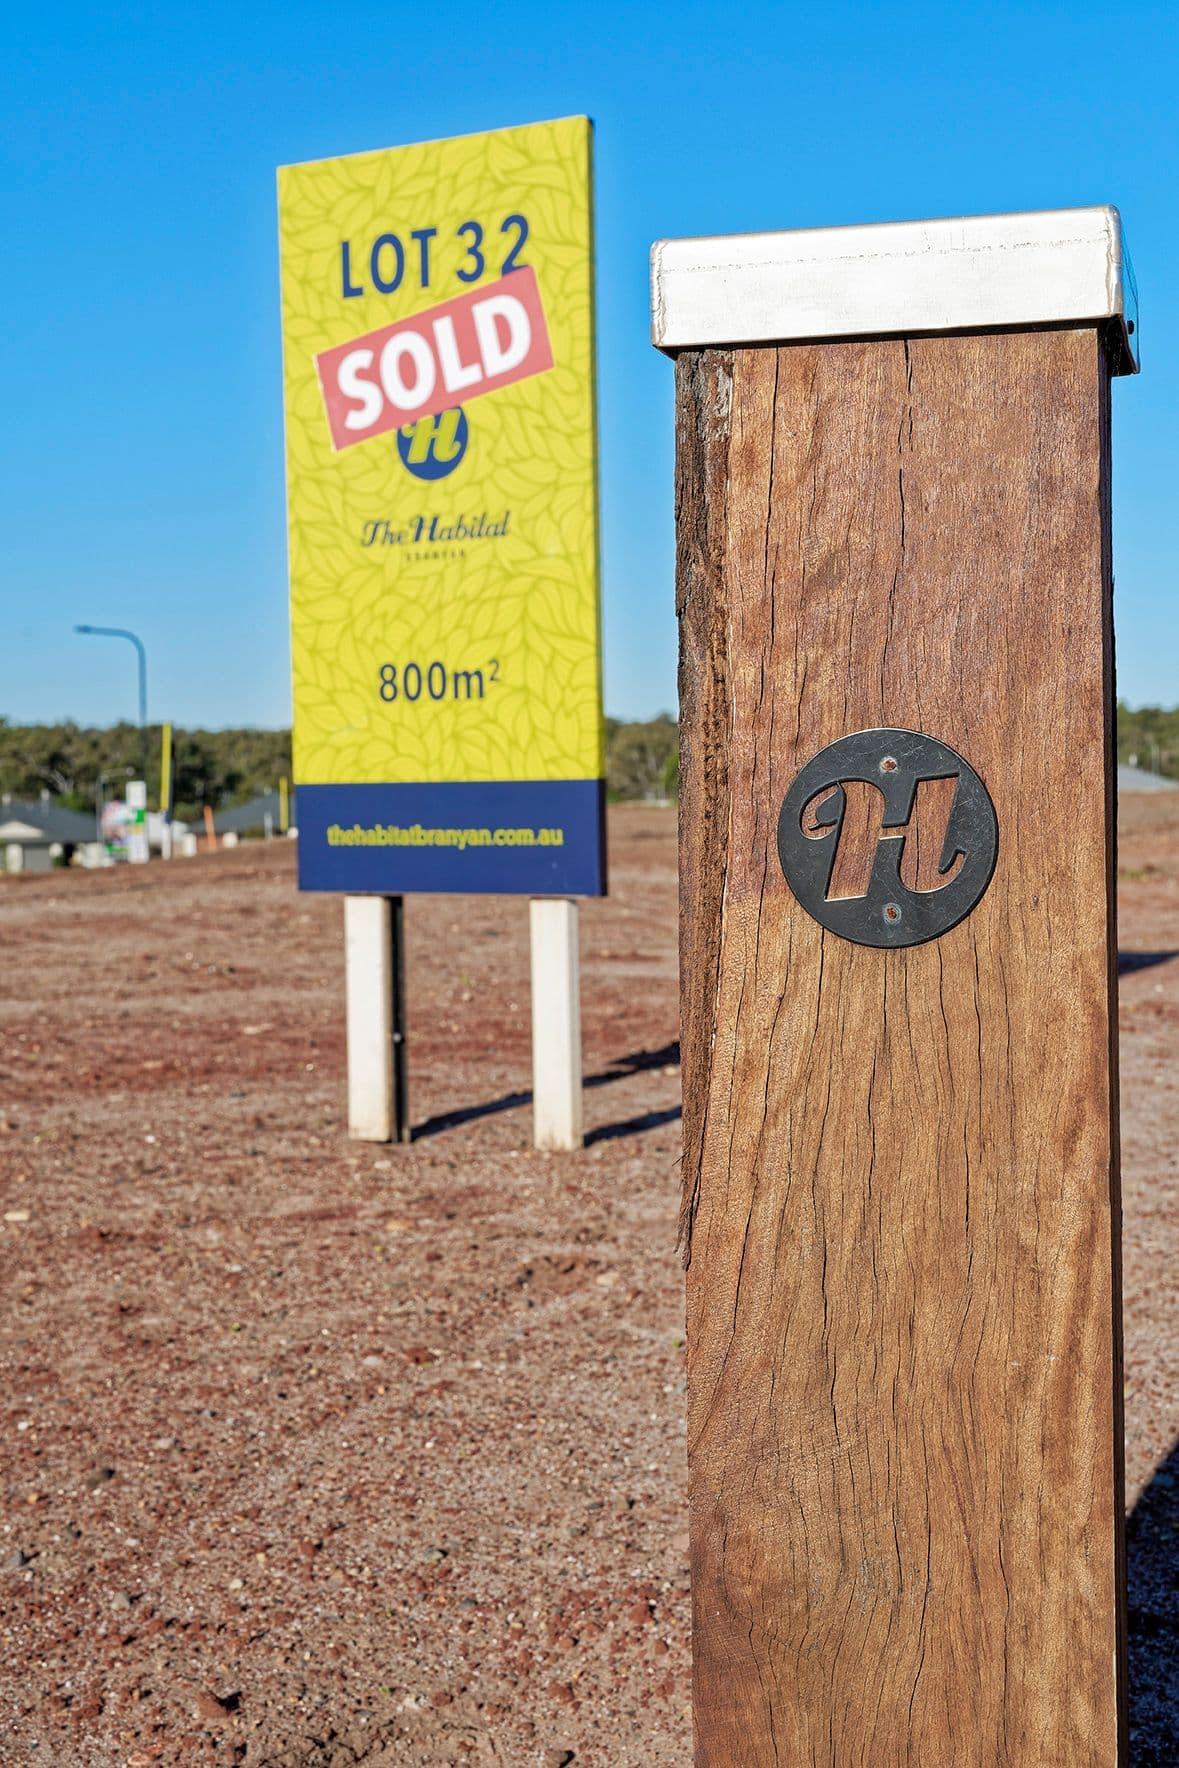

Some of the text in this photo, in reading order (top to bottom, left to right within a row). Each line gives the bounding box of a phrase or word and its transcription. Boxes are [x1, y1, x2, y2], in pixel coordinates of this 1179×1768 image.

[340, 214, 530, 298] LOT 32
[337, 294, 532, 430] SOLD
[401, 409, 462, 464] H
[361, 519, 404, 547] The
[327, 824, 564, 850] thehabitatbranyan.com.au
[799, 776, 967, 902] H
